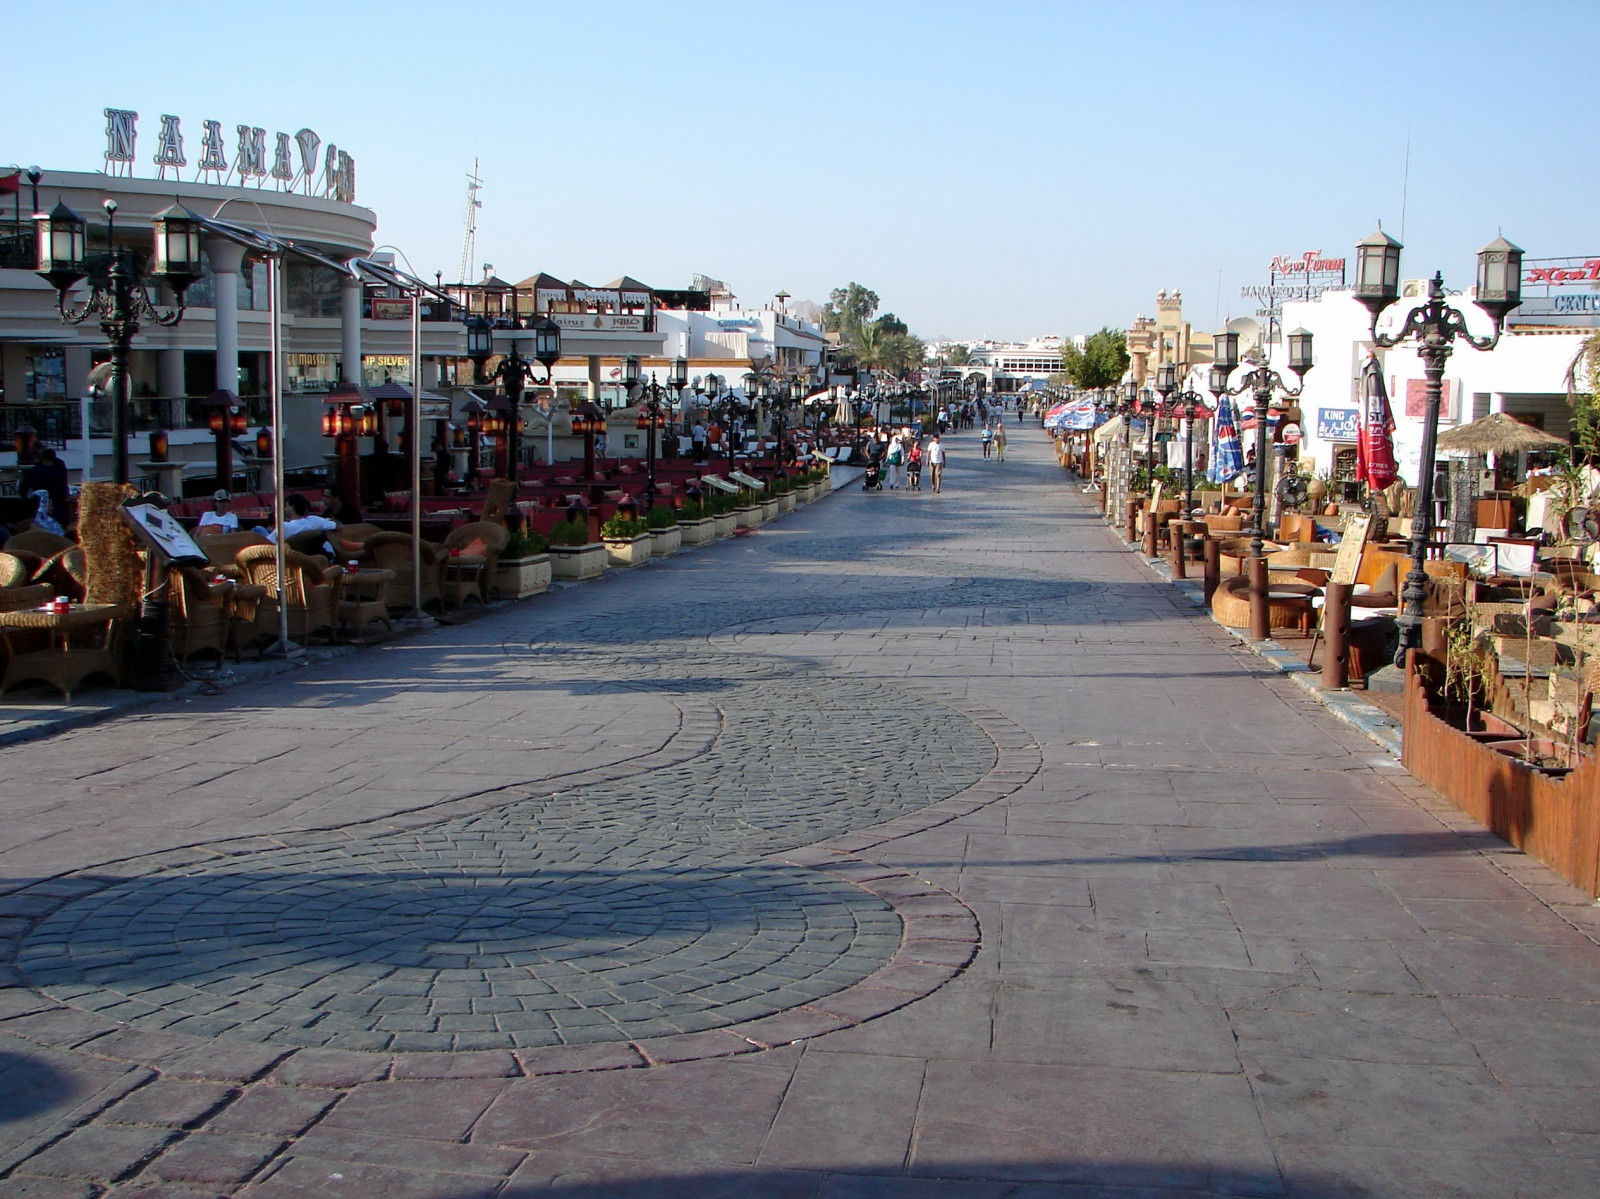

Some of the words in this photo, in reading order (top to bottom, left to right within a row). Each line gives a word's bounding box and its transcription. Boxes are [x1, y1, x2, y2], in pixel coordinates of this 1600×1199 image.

[104, 108, 293, 180] NAAMA
[1526, 267, 1586, 286] New
[538, 290, 566, 299] fairuz
[584, 291, 609, 300] fairuz
[552, 315, 585, 325] fairuz
[1324, 410, 1345, 421] KING
